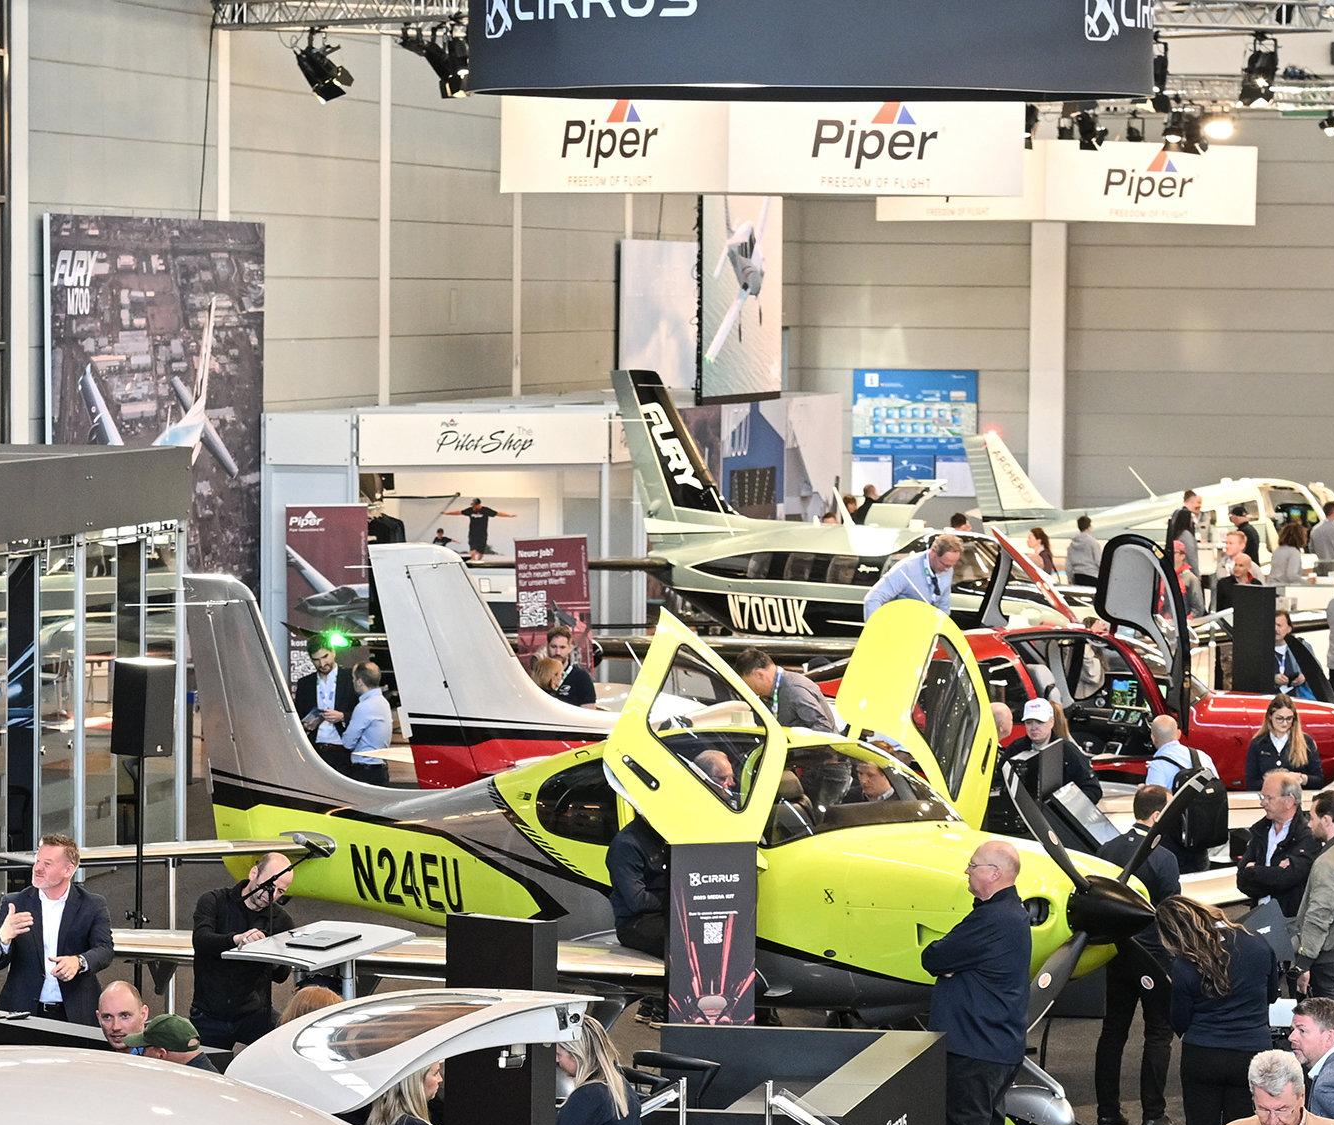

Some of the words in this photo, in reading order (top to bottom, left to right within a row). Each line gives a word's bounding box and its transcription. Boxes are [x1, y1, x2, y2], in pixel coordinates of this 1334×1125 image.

[562, 120, 658, 168] Piper
[811, 120, 938, 169] Piper
[568, 176, 607, 186] FREEDOM
[610, 176, 620, 186] OF
[624, 176, 653, 186] FLIGHT
[821, 176, 872, 188] FREEDOM
[876, 177, 889, 188] OF
[894, 178, 931, 189] FLIGHT
[1104, 169, 1194, 204] Piper
[53, 250, 99, 286] FURY
[67, 288, 90, 315] M700
[437, 430, 484, 453] Pilot
[482, 430, 534, 458] Shop
[517, 426, 533, 436] The
[641, 402, 704, 490] FURY
[992, 450, 1024, 491] ARCHER
[289, 516, 325, 528] Piper
[518, 550, 539, 558] Neuer
[539, 548, 554, 559] Job?
[551, 569, 576, 577] Talenten
[727, 594, 814, 636] N700UK
[350, 844, 464, 913] N24EU
[702, 874, 740, 883] CIRRUS
